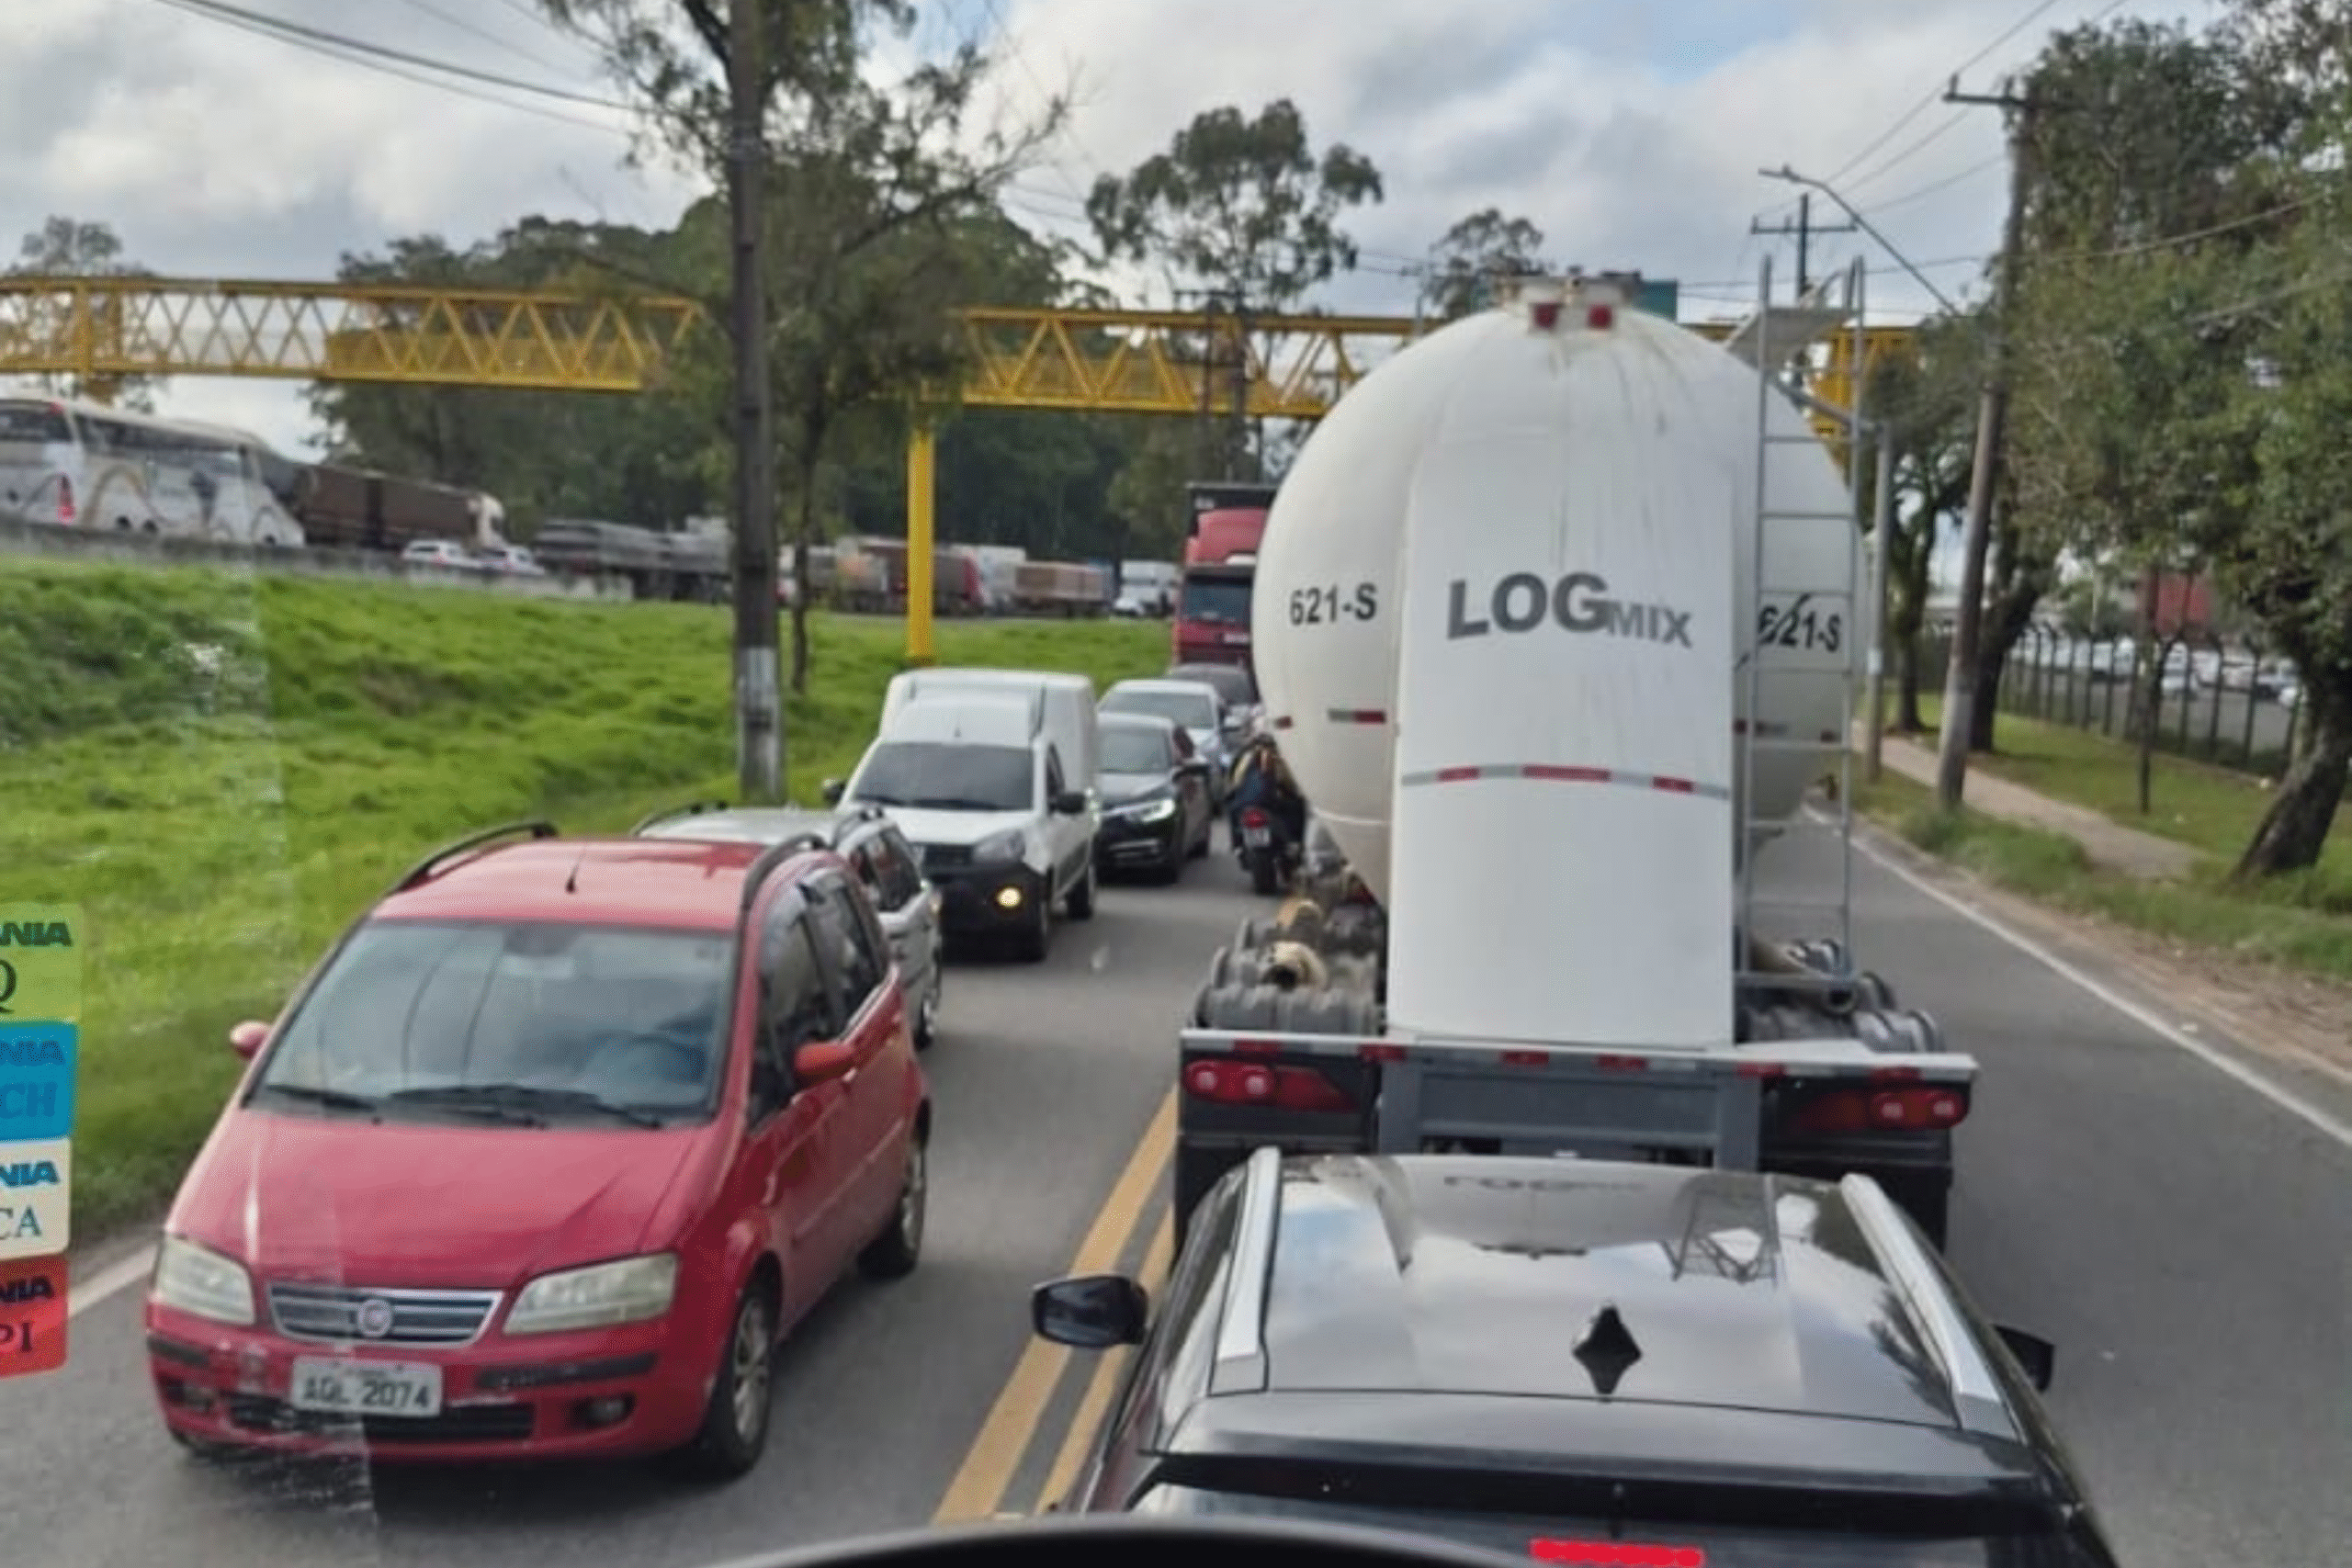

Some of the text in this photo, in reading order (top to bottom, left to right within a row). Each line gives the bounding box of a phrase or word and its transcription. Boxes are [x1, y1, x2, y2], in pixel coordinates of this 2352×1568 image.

[1290, 581, 1378, 625] 621-S
[1758, 605, 1840, 653] 621-S
[361, 1379, 429, 1409] 2074
